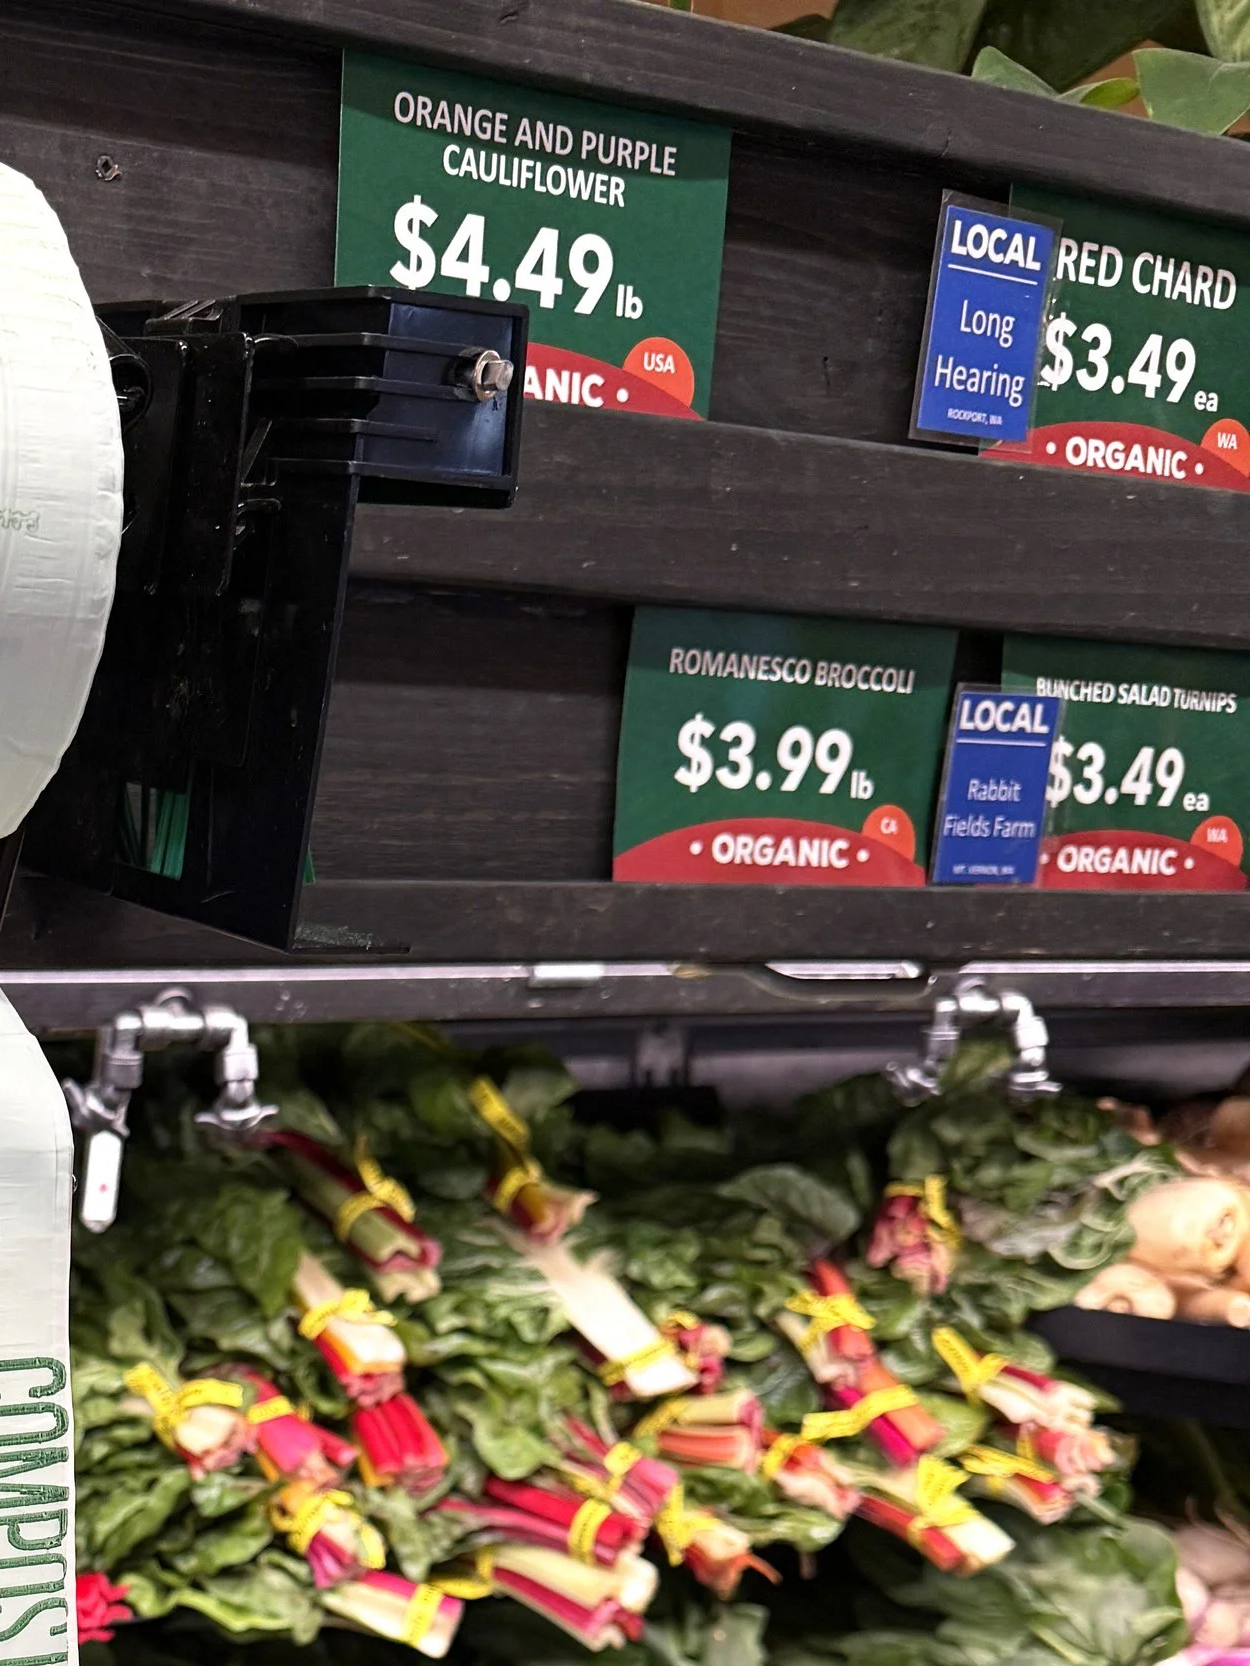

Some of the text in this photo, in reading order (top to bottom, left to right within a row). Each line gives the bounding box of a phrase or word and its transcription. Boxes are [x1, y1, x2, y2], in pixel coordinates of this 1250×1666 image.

[394, 91, 677, 176] ORANGE AND PURPLE
[443, 144, 625, 207] CAULIFLOWER
[389, 195, 643, 319] $4.49 lb
[951, 220, 1041, 271] LOCAL
[1056, 237, 1236, 310] RED CHARD
[960, 300, 1015, 348] Long
[644, 352, 675, 374] USA
[934, 355, 1025, 407] Hearing
[1040, 313, 1218, 412] $3.49 ea
[1065, 436, 1187, 479] ORGANIC
[1218, 432, 1237, 449] WA
[669, 648, 915, 694] ROMANESCO BROCCOLI
[960, 700, 1049, 734] LOCAL
[1036, 677, 1237, 713] BUNCHED SALAD TURNIPS
[674, 712, 874, 800] $3.99 lb
[1045, 734, 1210, 812] $3.49 ea
[968, 779, 1021, 802] Rabbit
[712, 833, 849, 869] ORGANIC
[944, 816, 1035, 839] Fields Farm
[1057, 846, 1177, 876] ORGANIC
